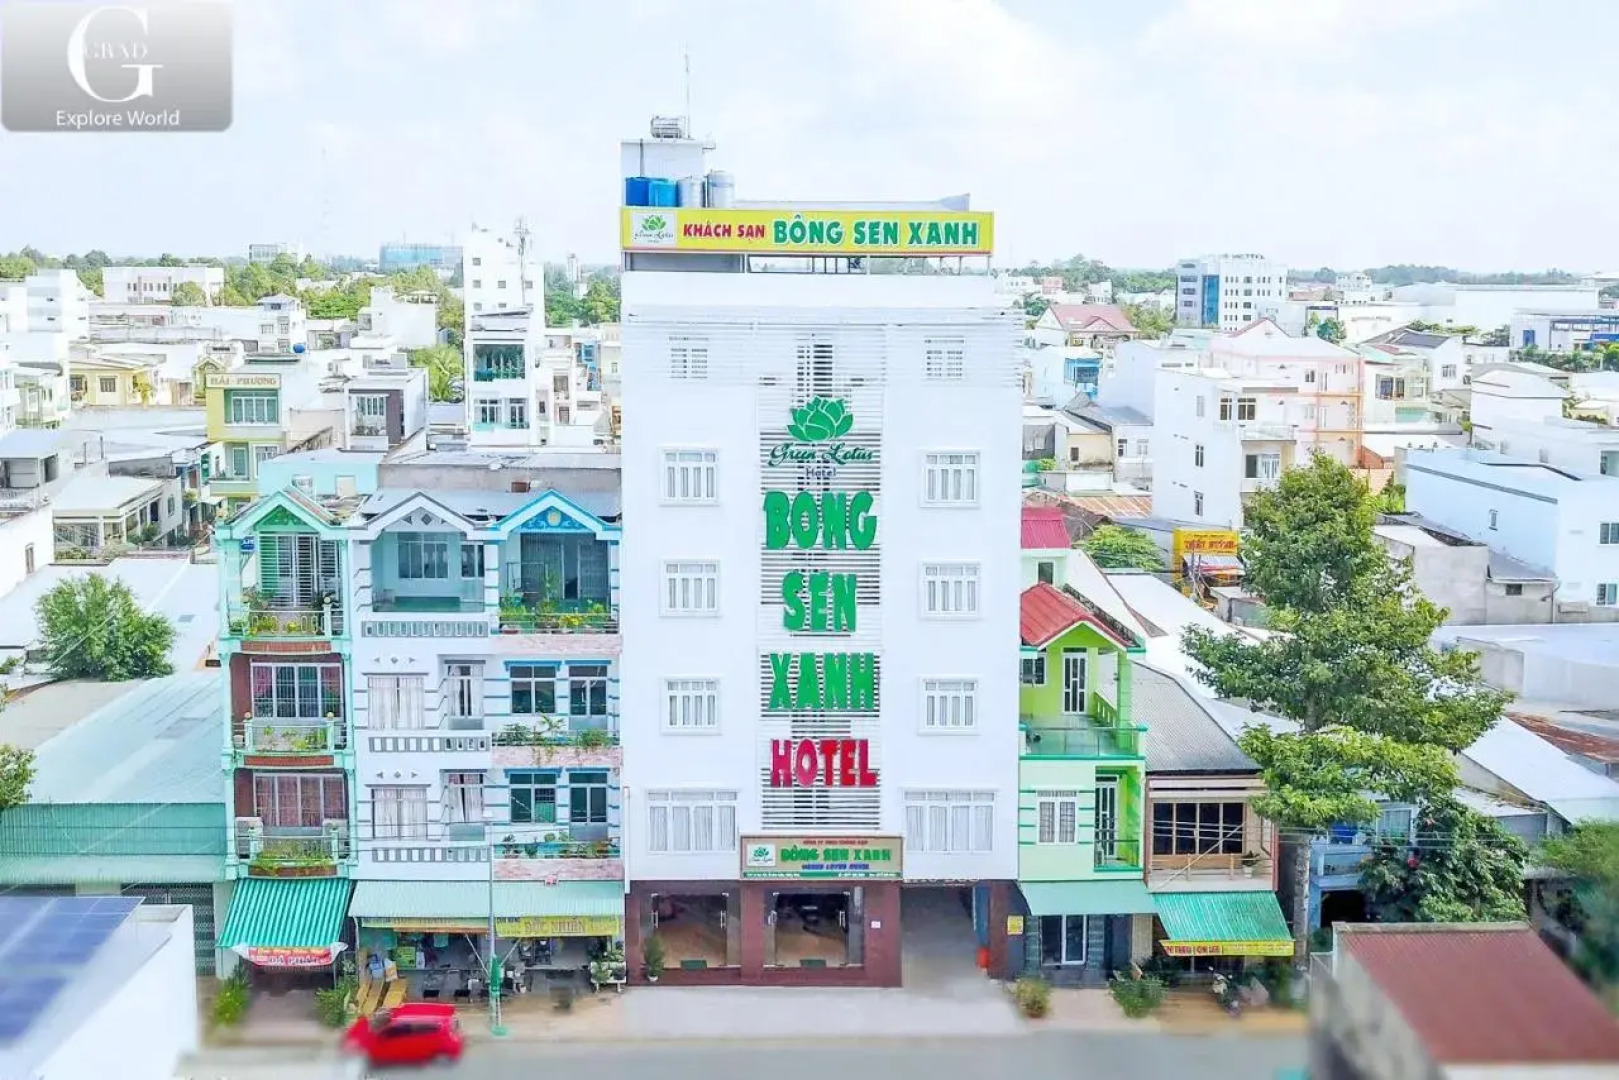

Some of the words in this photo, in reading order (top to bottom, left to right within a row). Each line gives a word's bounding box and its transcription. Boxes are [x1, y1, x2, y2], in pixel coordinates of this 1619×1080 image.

[683, 219, 732, 238] KHÁCH
[737, 224, 765, 244] SẠN
[773, 213, 844, 244] BÔNG
[853, 221, 899, 245] SEN
[908, 222, 978, 245] XANH
[768, 442, 817, 466] Green
[822, 442, 873, 465] Lotus
[805, 467, 837, 477] Hotel
[782, 569, 857, 632] SEN
[768, 652, 875, 710] XANH
[770, 738, 879, 788] HOTEL
